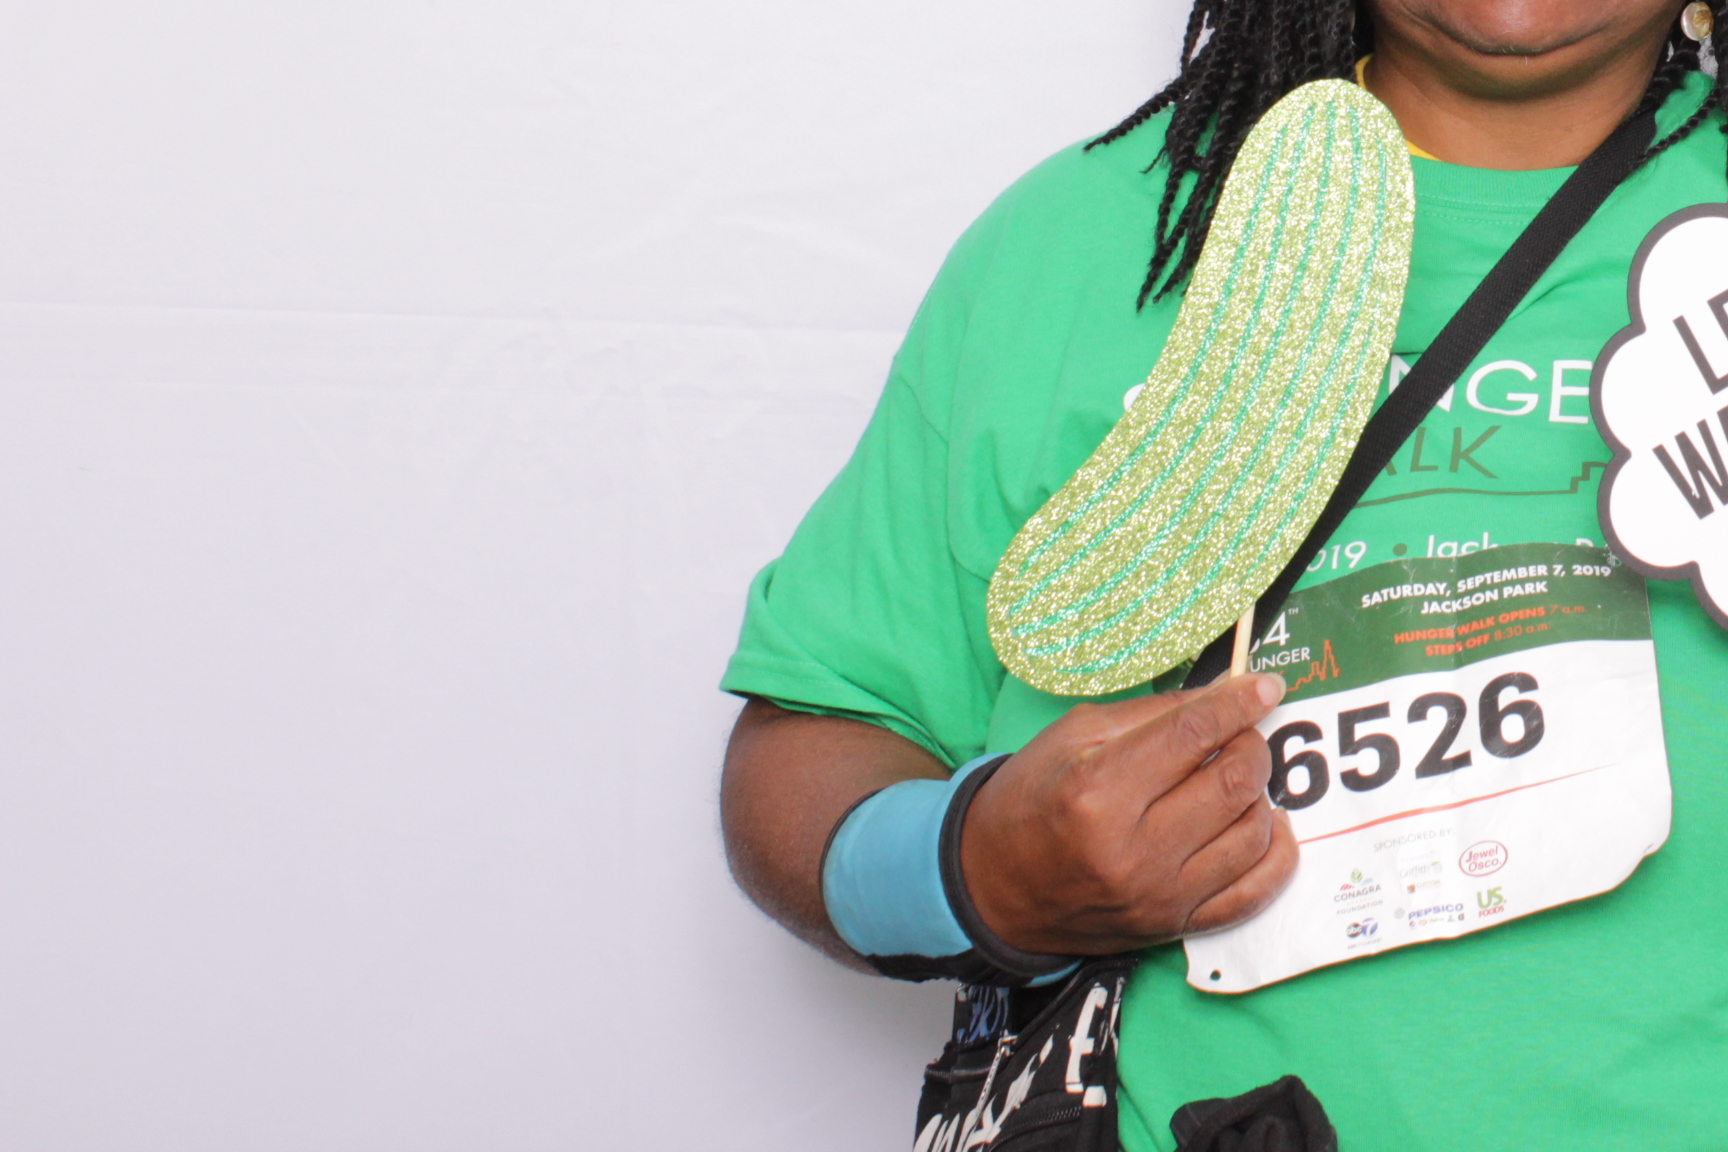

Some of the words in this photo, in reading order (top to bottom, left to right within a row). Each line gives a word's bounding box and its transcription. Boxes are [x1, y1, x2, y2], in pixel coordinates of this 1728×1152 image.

[1381, 425, 1502, 479] LK
[1361, 581, 1451, 609] SATURDAY,
[1457, 565, 1549, 593] SEPTEMBER
[1553, 565, 1566, 578] 7,
[1571, 564, 1612, 577] 2019
[1420, 589, 1499, 615] JACKSON
[1502, 581, 1549, 599] PARK
[1393, 627, 1455, 645] HUNGER
[1456, 616, 1496, 636] WALK
[1498, 606, 1547, 623] OPENS
[1550, 604, 1559, 615] 7
[1561, 605, 1588, 614] a.m.
[1425, 641, 1463, 656] STEPS
[1465, 633, 1491, 651] OFF
[1494, 625, 1523, 642] 8:30
[1525, 621, 1551, 634] a.m.
[1249, 647, 1311, 673] UNGER
[1265, 671, 1546, 811] 6526
[1373, 829, 1437, 853] SPONSORED
[1465, 845, 1499, 863] Jewel
[1400, 864, 1430, 879] Griffith
[1333, 883, 1382, 903] CONAGRA
[1336, 899, 1384, 915] FOUNDATION
[1407, 903, 1465, 921] PEPSICO
[1478, 905, 1505, 918] FOODS
